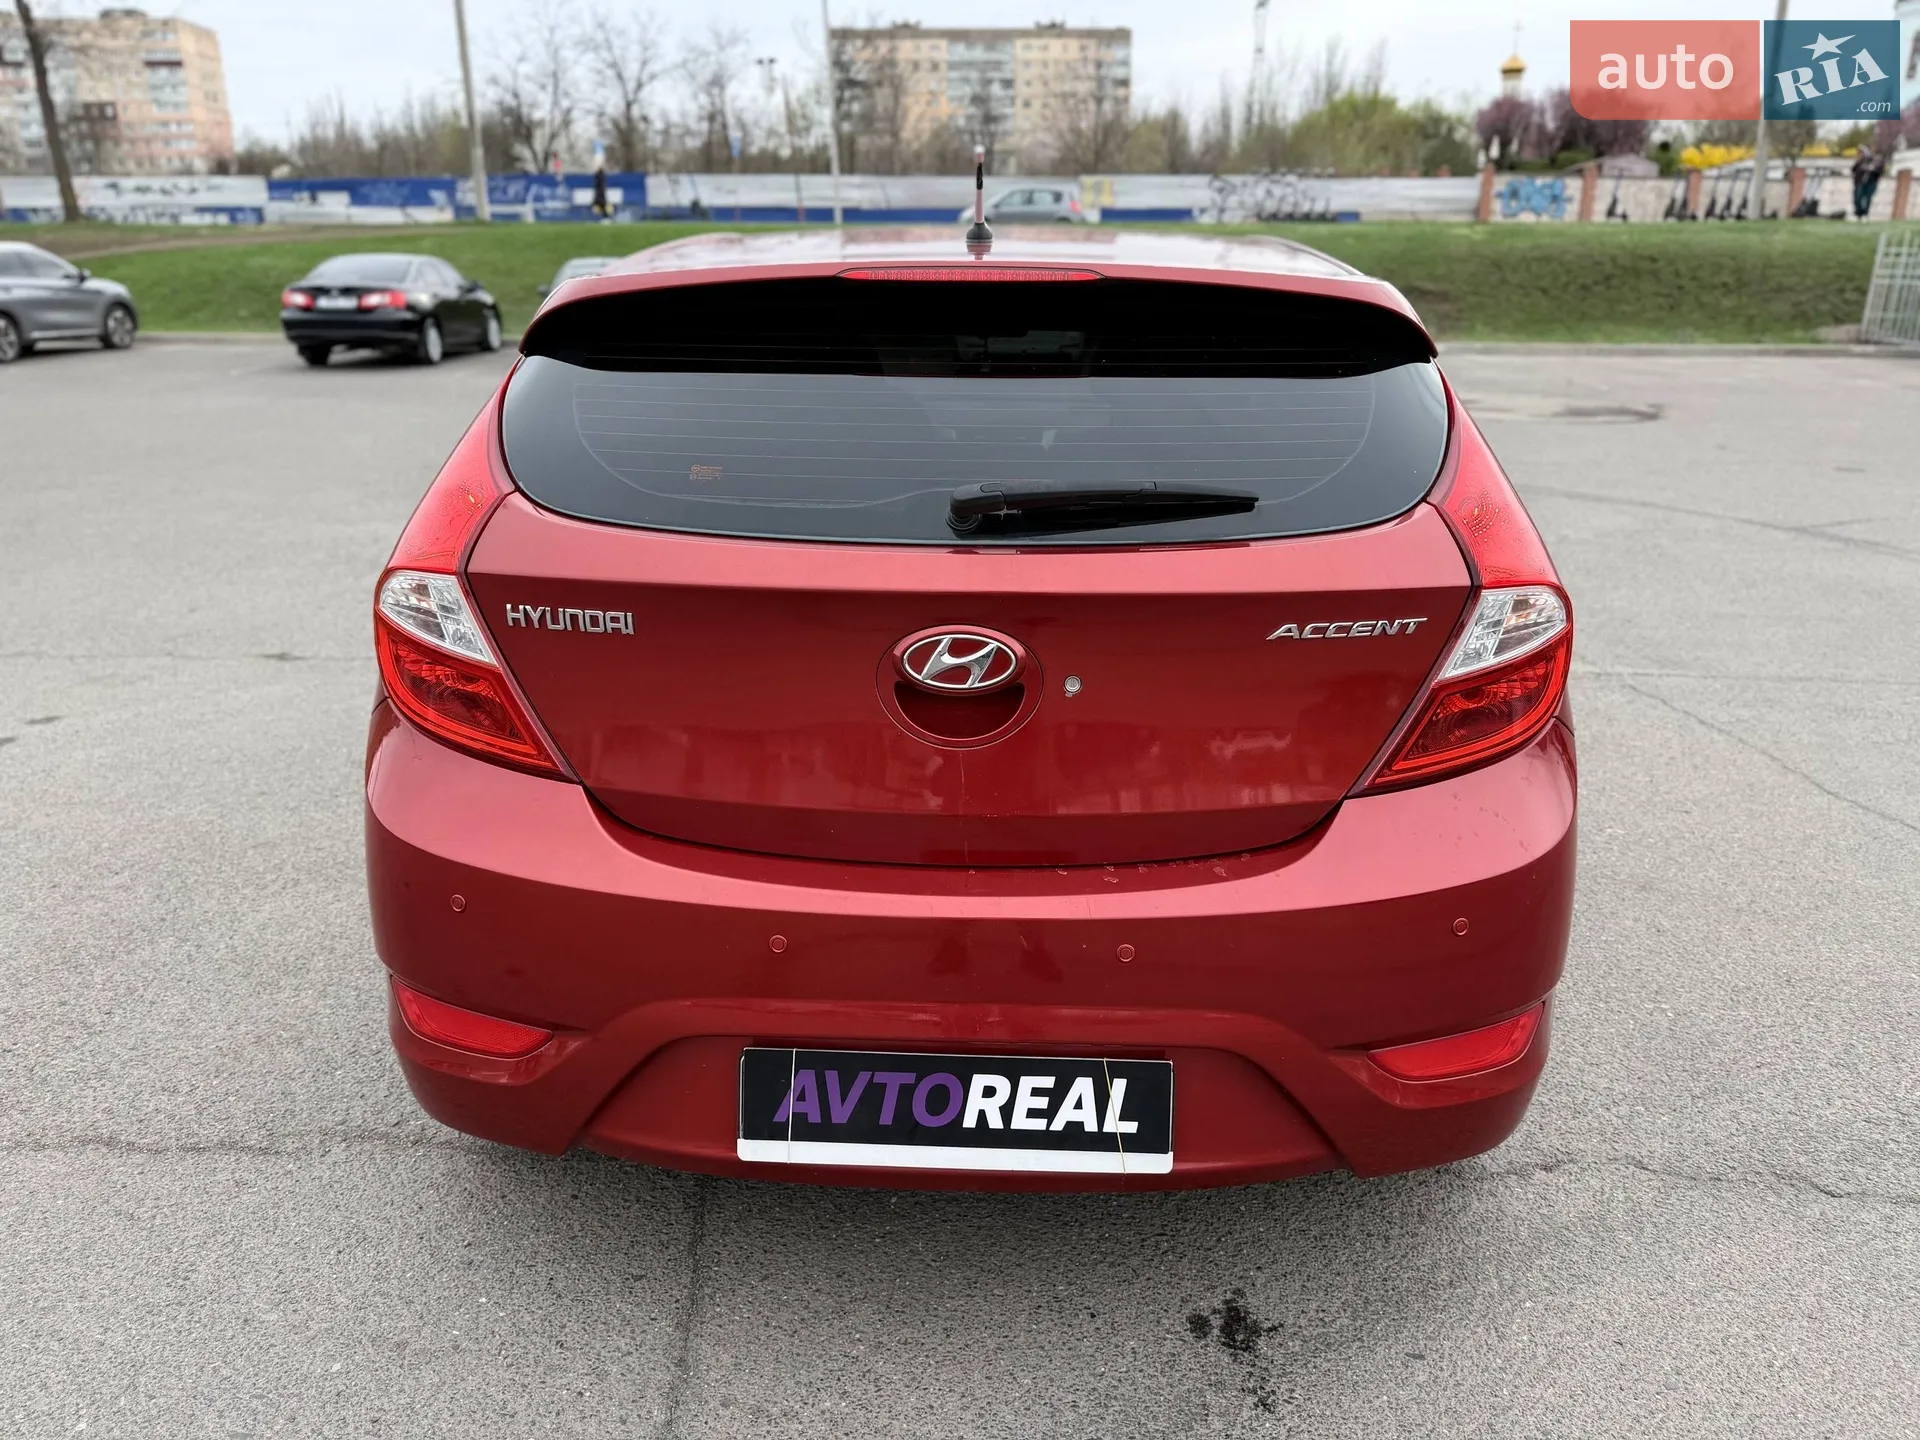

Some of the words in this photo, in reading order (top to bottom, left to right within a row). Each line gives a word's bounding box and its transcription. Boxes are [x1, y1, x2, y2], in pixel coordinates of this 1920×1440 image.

[505, 603, 635, 635] HYUNDAI
[1265, 617, 1428, 641] ACCENT
[772, 1068, 1139, 1134] AVTOREAL
